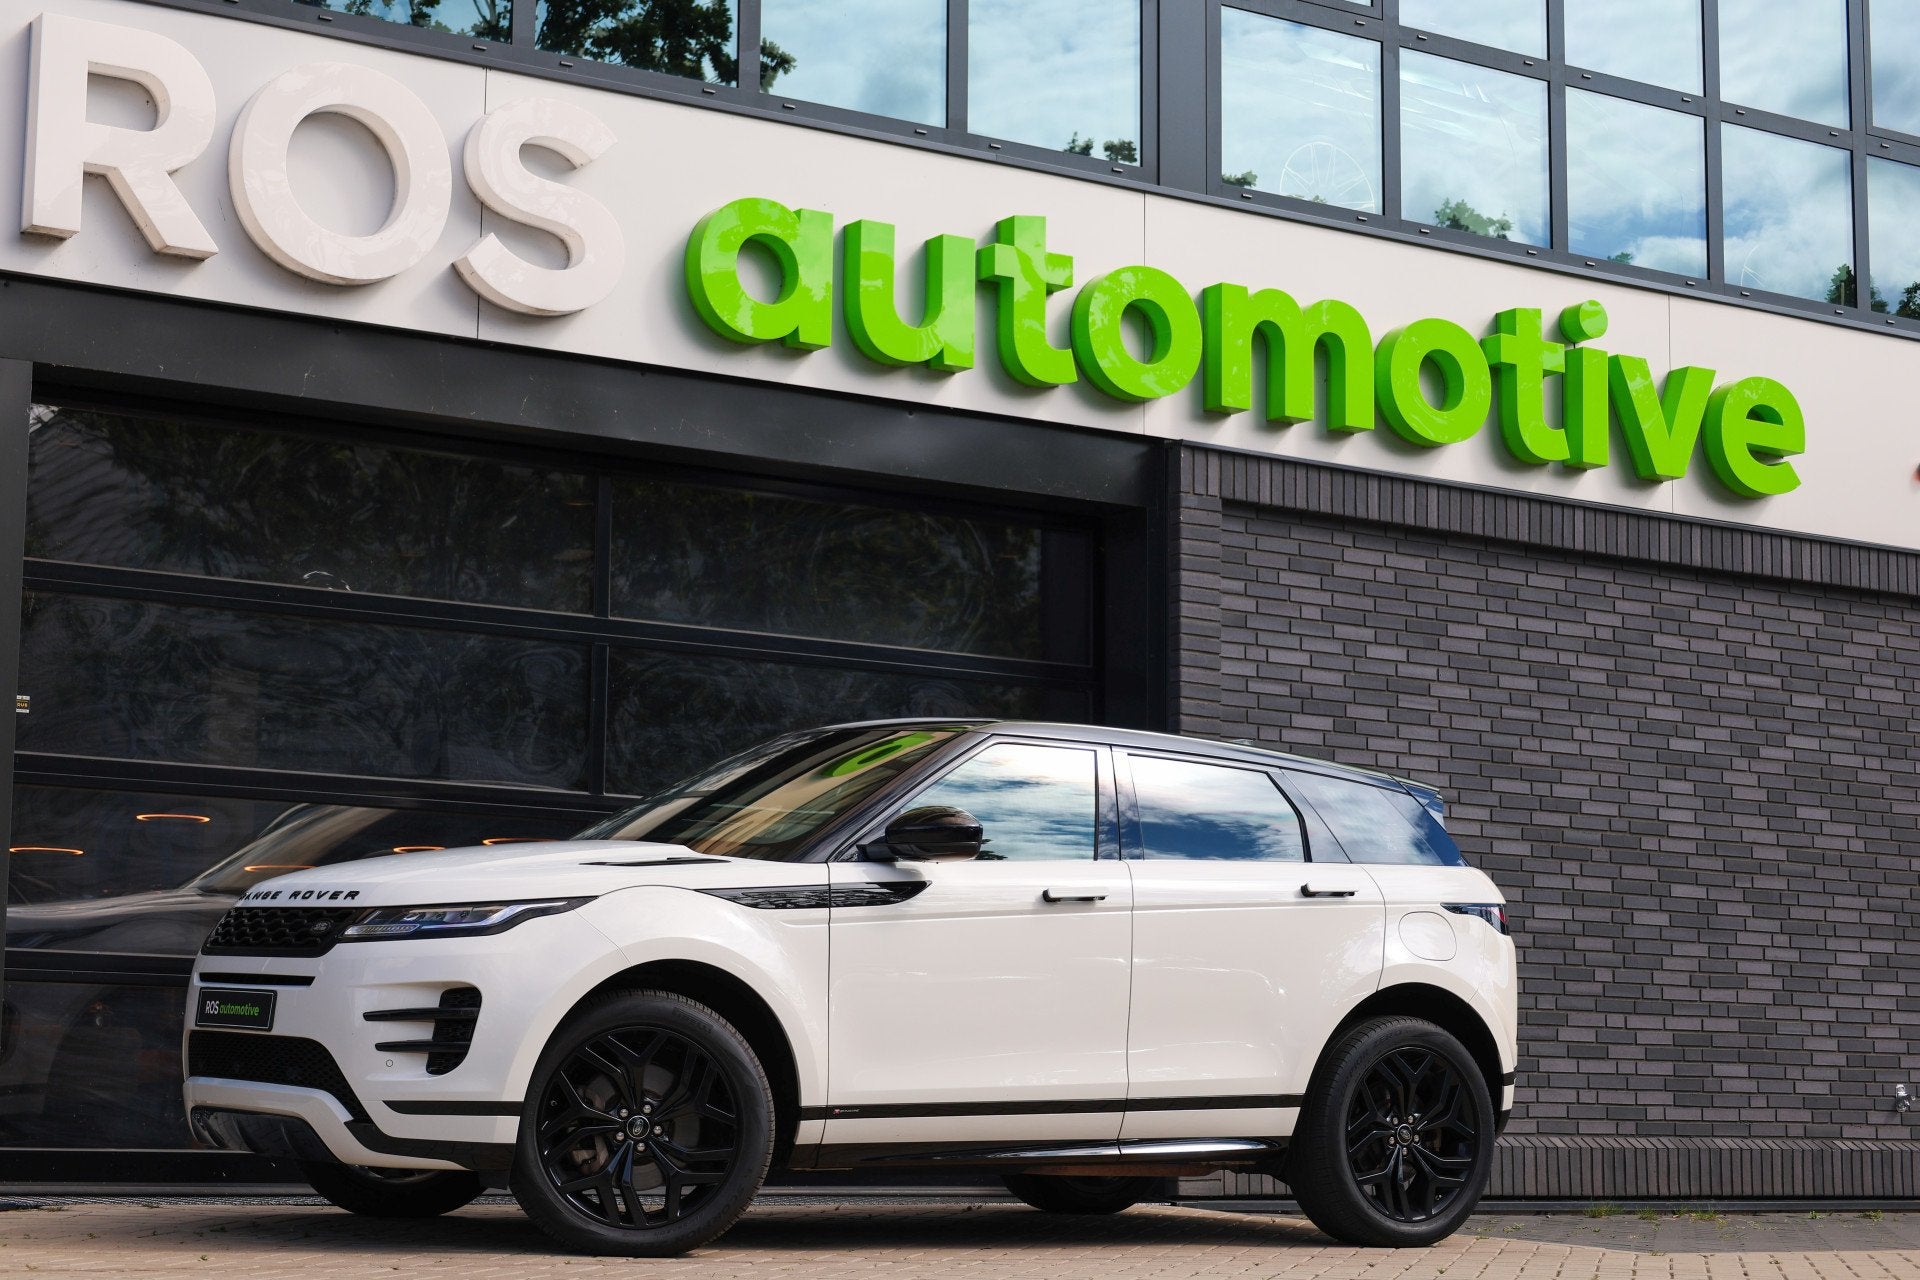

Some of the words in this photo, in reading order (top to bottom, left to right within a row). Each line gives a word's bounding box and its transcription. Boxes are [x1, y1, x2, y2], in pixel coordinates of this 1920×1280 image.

[20, 12, 625, 317] ROS
[685, 197, 1806, 498] automotive
[288, 890, 360, 900] ROVER
[205, 1000, 220, 1015] ROS
[219, 1002, 260, 1016] automotive
